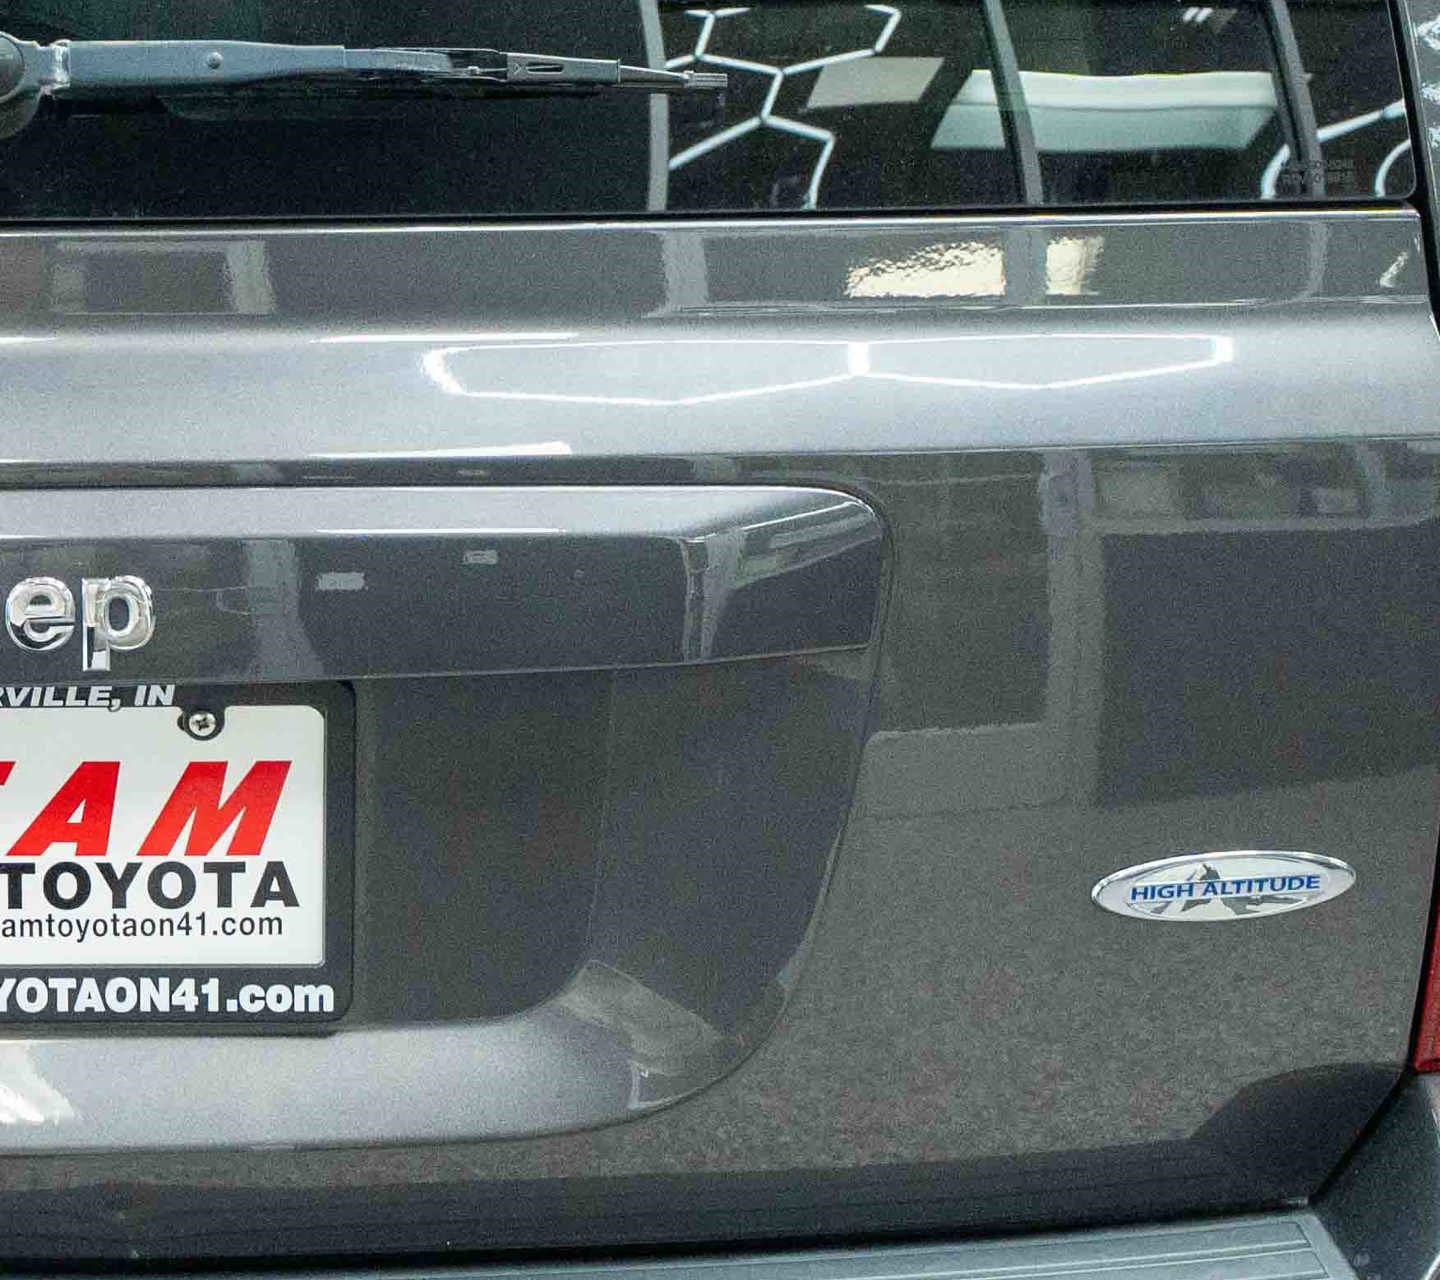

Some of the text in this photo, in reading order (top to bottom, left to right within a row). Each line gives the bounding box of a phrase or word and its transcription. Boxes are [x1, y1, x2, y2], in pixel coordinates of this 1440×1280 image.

[134, 684, 176, 707] IN
[1130, 873, 1322, 902] HIGH ALTITUDE
